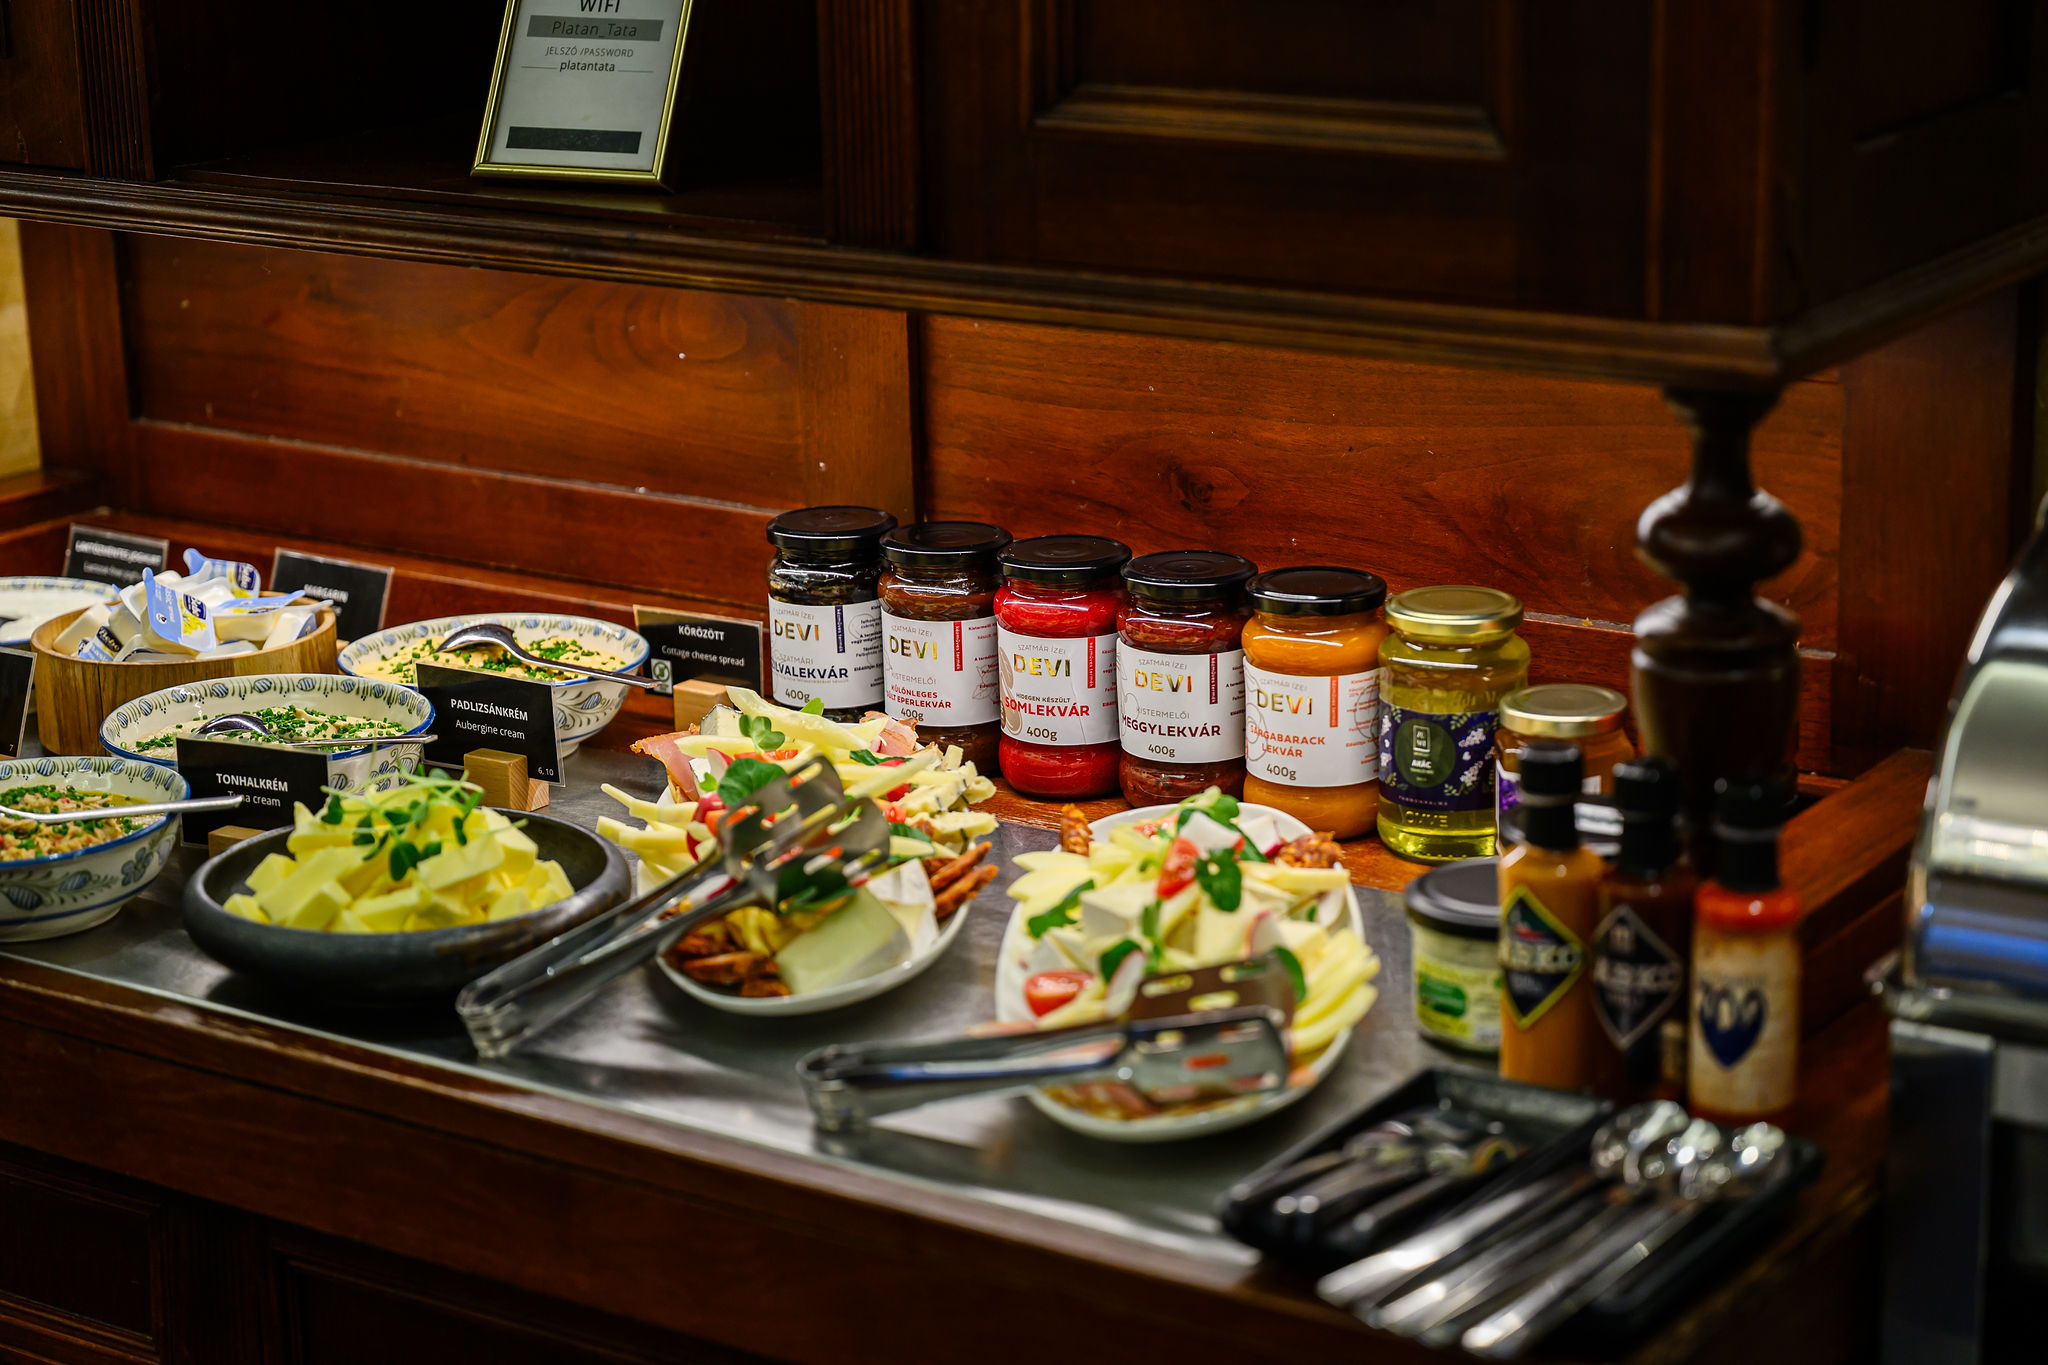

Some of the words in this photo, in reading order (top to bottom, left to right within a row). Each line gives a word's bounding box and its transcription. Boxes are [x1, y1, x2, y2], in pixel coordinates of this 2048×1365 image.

[580, 0, 620, 12] WIFI
[552, 20, 637, 38] Platan_Tata
[545, 46, 577, 56] JELSZÓ
[559, 60, 615, 72] platantata
[678, 625, 725, 641] KÖRÖZÖTT
[775, 618, 820, 641] DEVI
[889, 635, 937, 659] DEVI
[1017, 644, 1049, 652] SZATMÁR
[662, 645, 690, 658] Cottage
[691, 650, 717, 663] cheese
[719, 655, 745, 667] spread
[772, 660, 848, 679] LVALEKVÁR
[1014, 653, 1070, 677] DEVI
[1139, 659, 1170, 667] SZATMÁR
[1172, 661, 1187, 670] ÍZEI
[1135, 668, 1192, 693] DEVI
[785, 688, 810, 704] 400g
[891, 684, 938, 698] KÜLÖNLEGES
[1016, 693, 1041, 702] HIDEGEN
[450, 698, 528, 721] PADLIZSÁNKRÉM
[897, 696, 952, 708] EPERLEKVÁR
[1005, 696, 1090, 717] SOMLEKVÁR
[1257, 688, 1312, 715] DEVI
[901, 707, 924, 721] 400g
[1137, 708, 1190, 719] KISTERMELŐI
[456, 720, 498, 735] Aubergine
[500, 728, 525, 740] cream
[1122, 713, 1221, 737] MEGGYLEKVÁR
[1027, 726, 1058, 741] 400g
[1250, 724, 1326, 745] SÁRGABARACK
[9, 744, 14, 752] 7
[1148, 744, 1176, 758] 400g
[1262, 743, 1303, 757] LEKVÁR
[1267, 764, 1296, 780] 400g
[216, 773, 288, 792] TONHALKRÉM
[228, 791, 251, 803] Ta
[253, 795, 281, 807] cream
